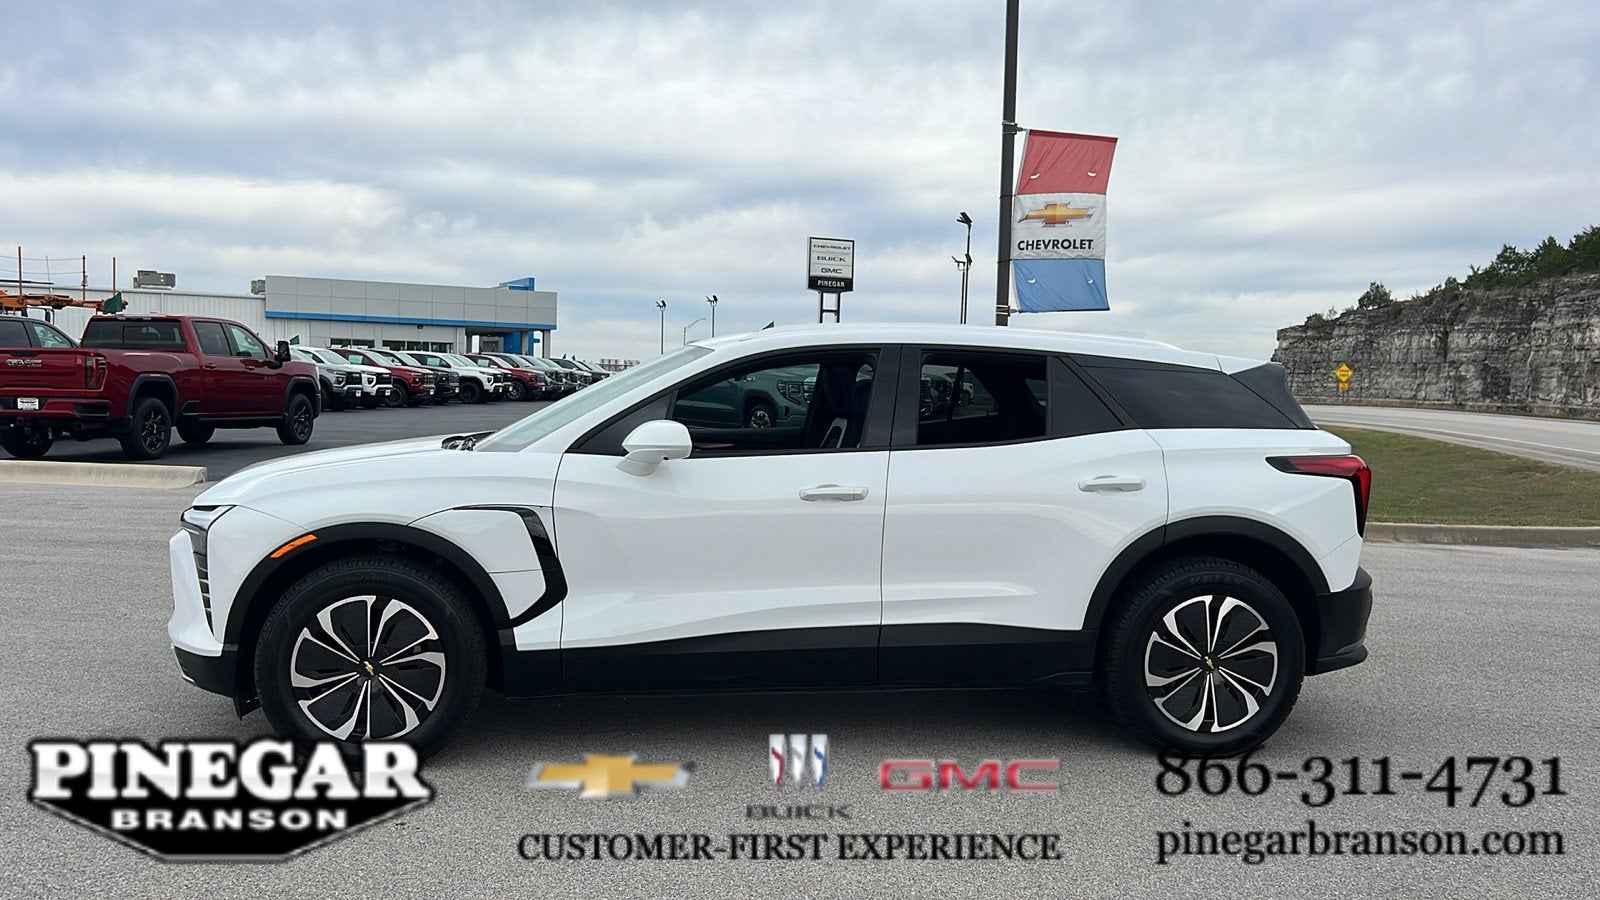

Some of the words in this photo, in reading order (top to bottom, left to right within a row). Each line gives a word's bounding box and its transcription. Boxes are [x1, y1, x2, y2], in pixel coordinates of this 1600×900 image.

[1017, 238, 1094, 251] CHEVROLET
[821, 267, 843, 275] GMC
[817, 279, 845, 288] PINEGAR
